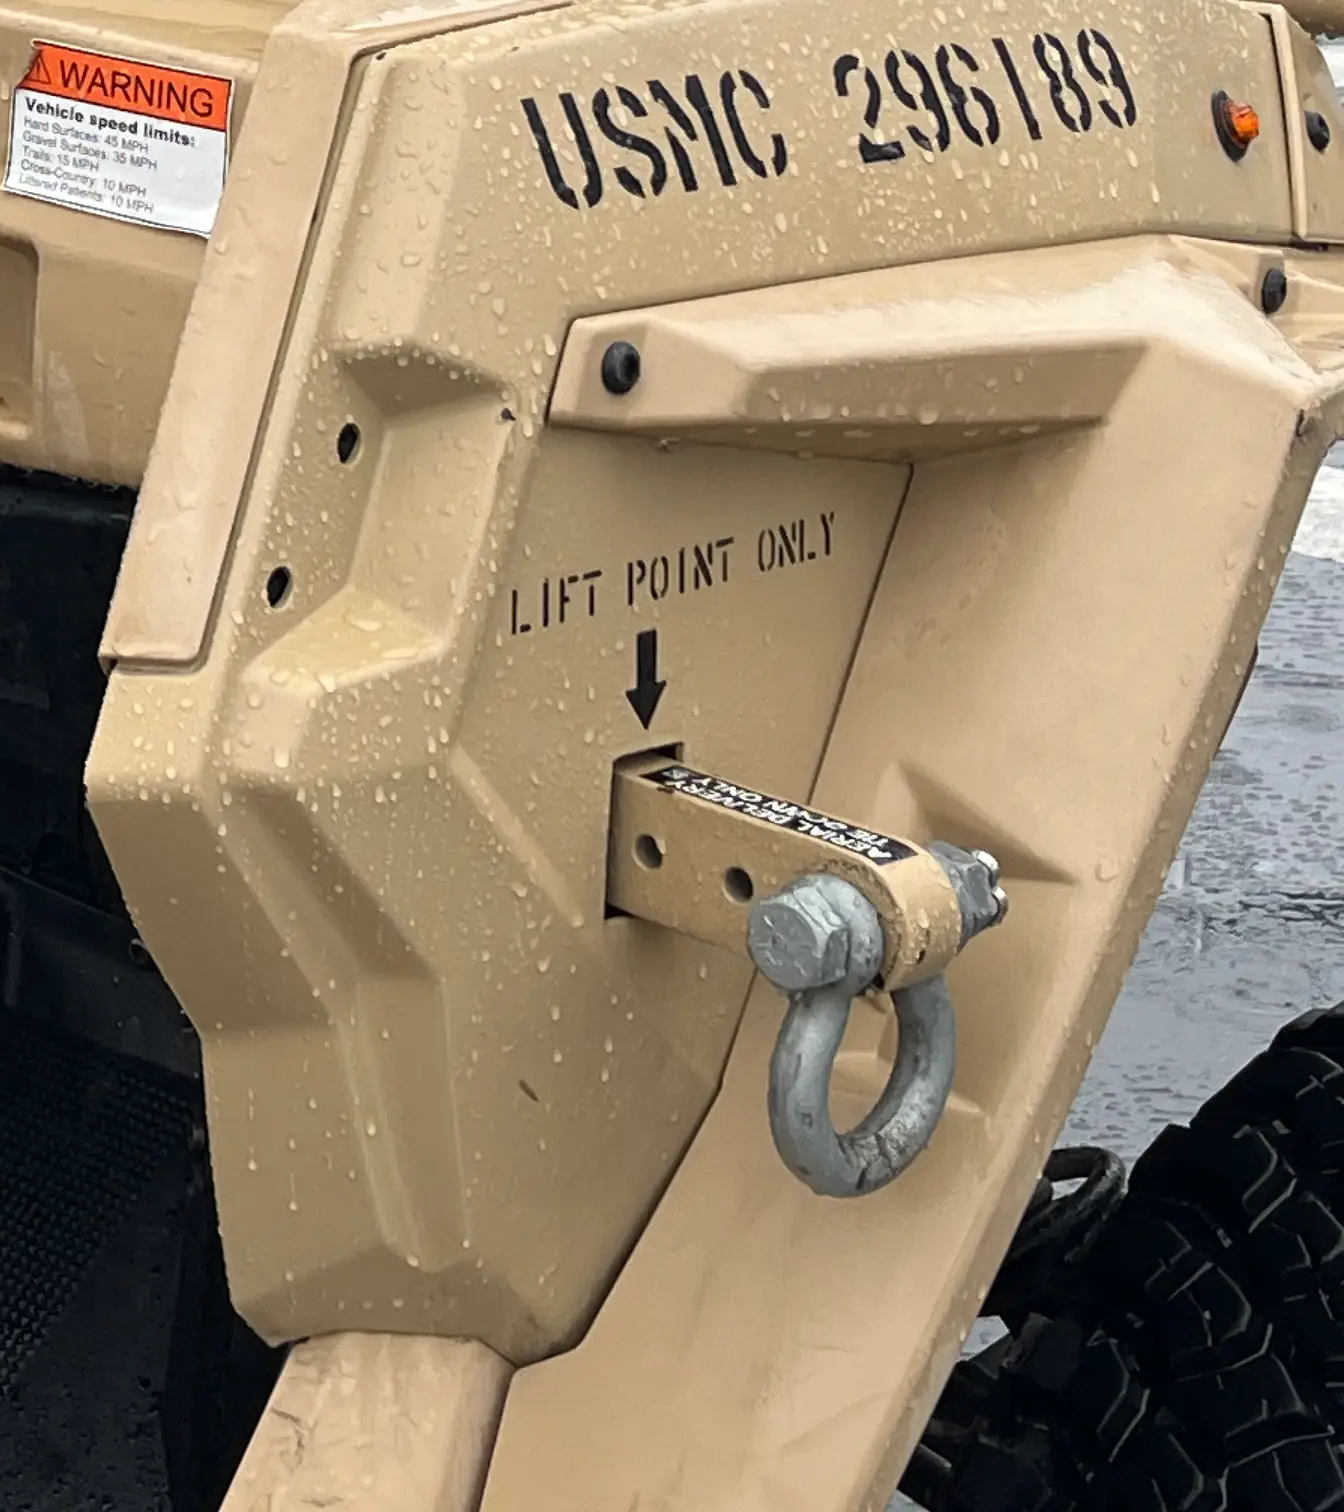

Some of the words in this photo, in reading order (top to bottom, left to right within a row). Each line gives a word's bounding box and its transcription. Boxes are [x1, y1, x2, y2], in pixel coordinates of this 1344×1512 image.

[59, 59, 214, 118] WARNING
[24, 96, 84, 123] Vehicle
[89, 114, 138, 136] speed
[143, 122, 196, 148] limits:
[520, 69, 788, 210] USMC
[832, 27, 1137, 164] 296189
[104, 134, 119, 148] 45
[121, 138, 149, 154] MPH
[113, 151, 127, 165] 35
[129, 154, 158, 170] MPH
[57, 153, 70, 166] 15
[72, 156, 100, 172] MPH
[103, 178, 116, 191] 10
[118, 182, 147, 197] MPH
[111, 195, 124, 208] 10
[126, 198, 154, 213] MPH
[511, 569, 603, 636] LIFT
[626, 536, 735, 607] POINT
[757, 511, 835, 572] ONLY
[665, 779, 792, 825] DELIVERY
[691, 777, 763, 803] ONLY
[797, 819, 893, 859] AERIAL
